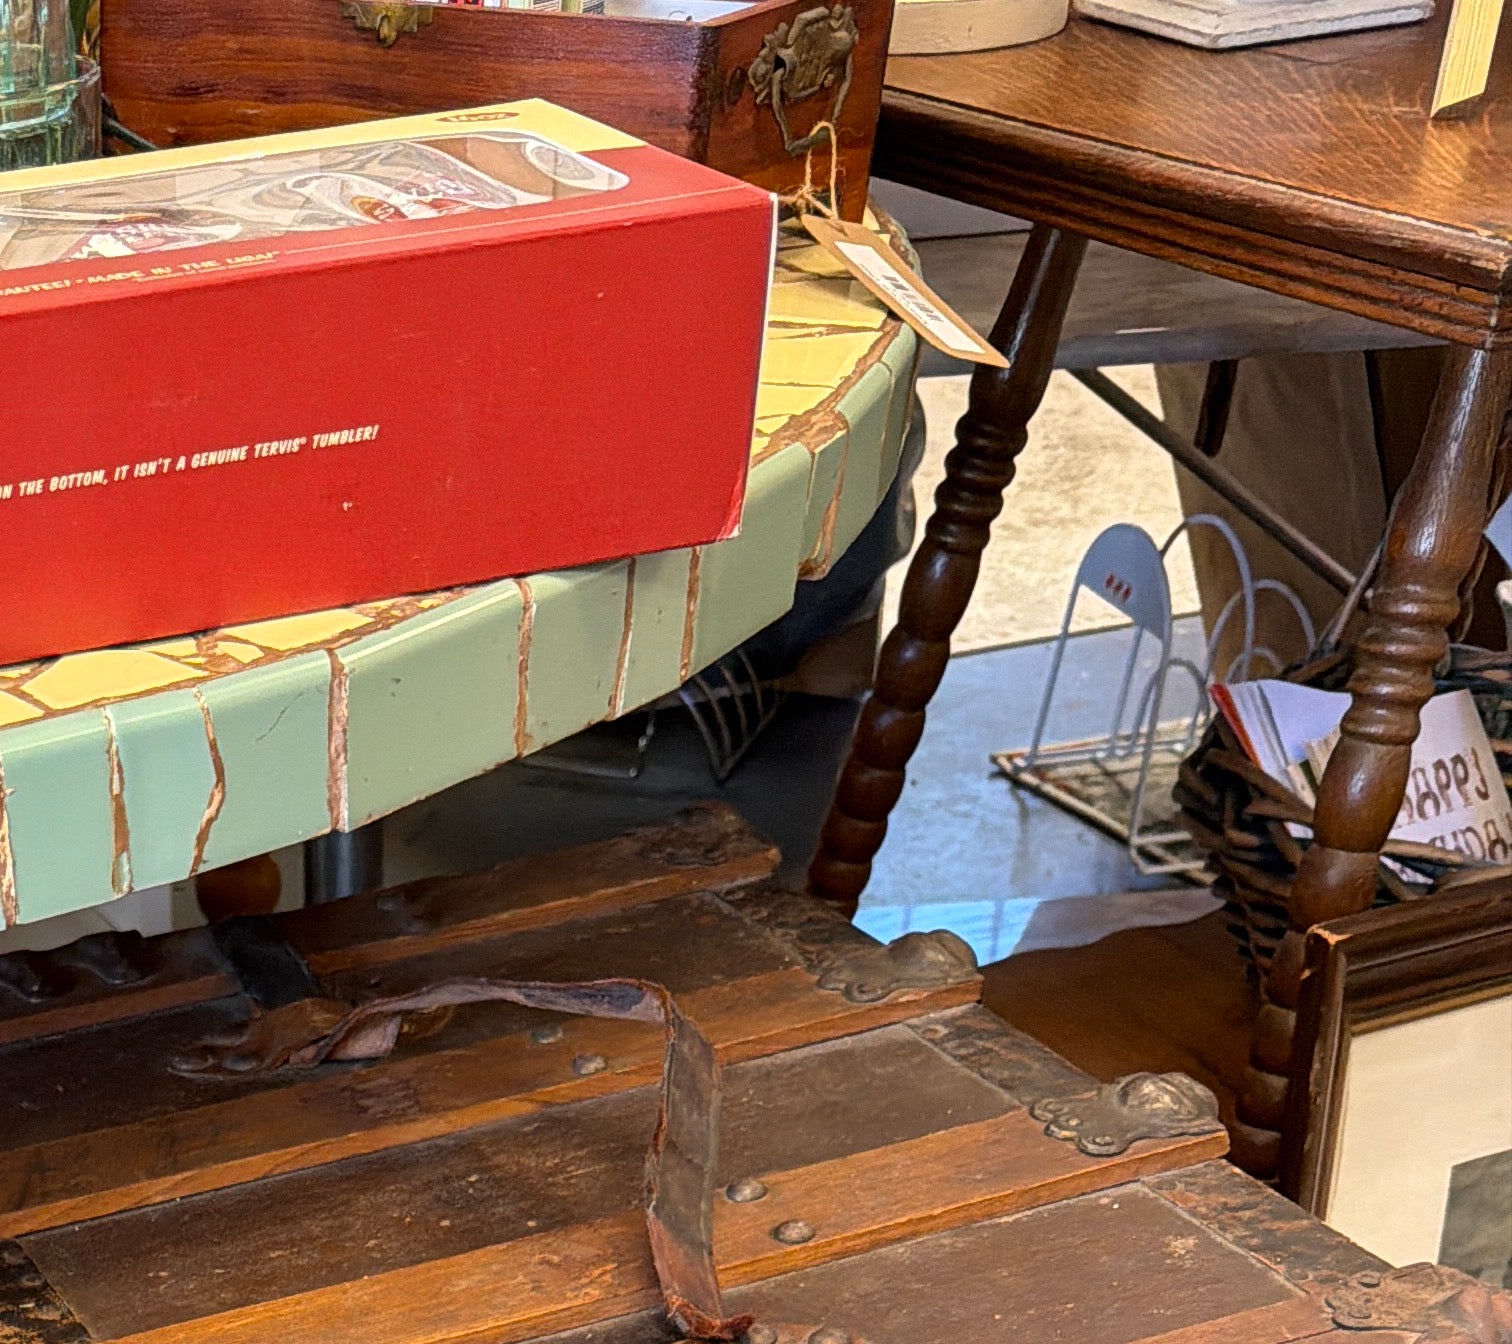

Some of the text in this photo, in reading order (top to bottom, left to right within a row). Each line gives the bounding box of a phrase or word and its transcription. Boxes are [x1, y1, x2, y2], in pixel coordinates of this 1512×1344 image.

[87, 269, 145, 284] MADE
[18, 479, 44, 497] THE
[49, 469, 108, 492] BOTTOM,
[114, 465, 129, 481] IT
[134, 457, 171, 478] ISN'T
[176, 455, 187, 471] A
[191, 446, 249, 469] GENUINE
[312, 425, 379, 449] TUMBLER!
